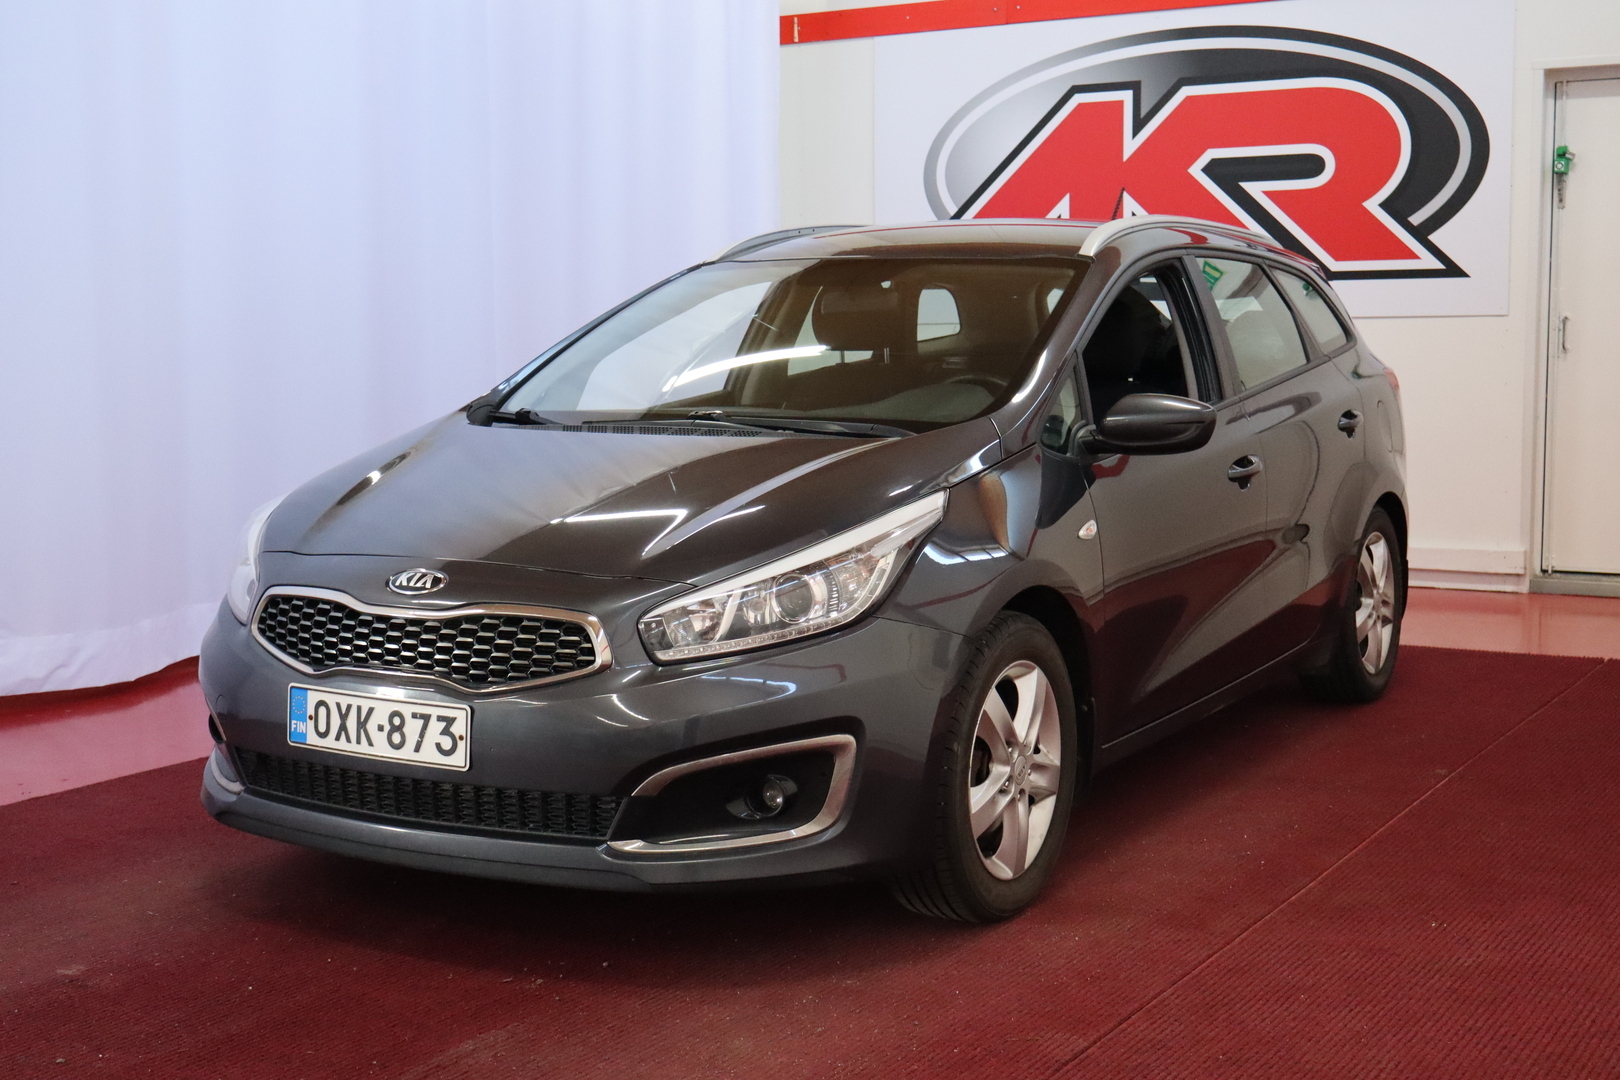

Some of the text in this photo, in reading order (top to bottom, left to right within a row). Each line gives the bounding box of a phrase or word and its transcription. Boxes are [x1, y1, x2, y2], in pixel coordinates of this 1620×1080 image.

[394, 572, 435, 589] KIA
[291, 719, 306, 734] FIN
[313, 699, 458, 757] OXK-873
